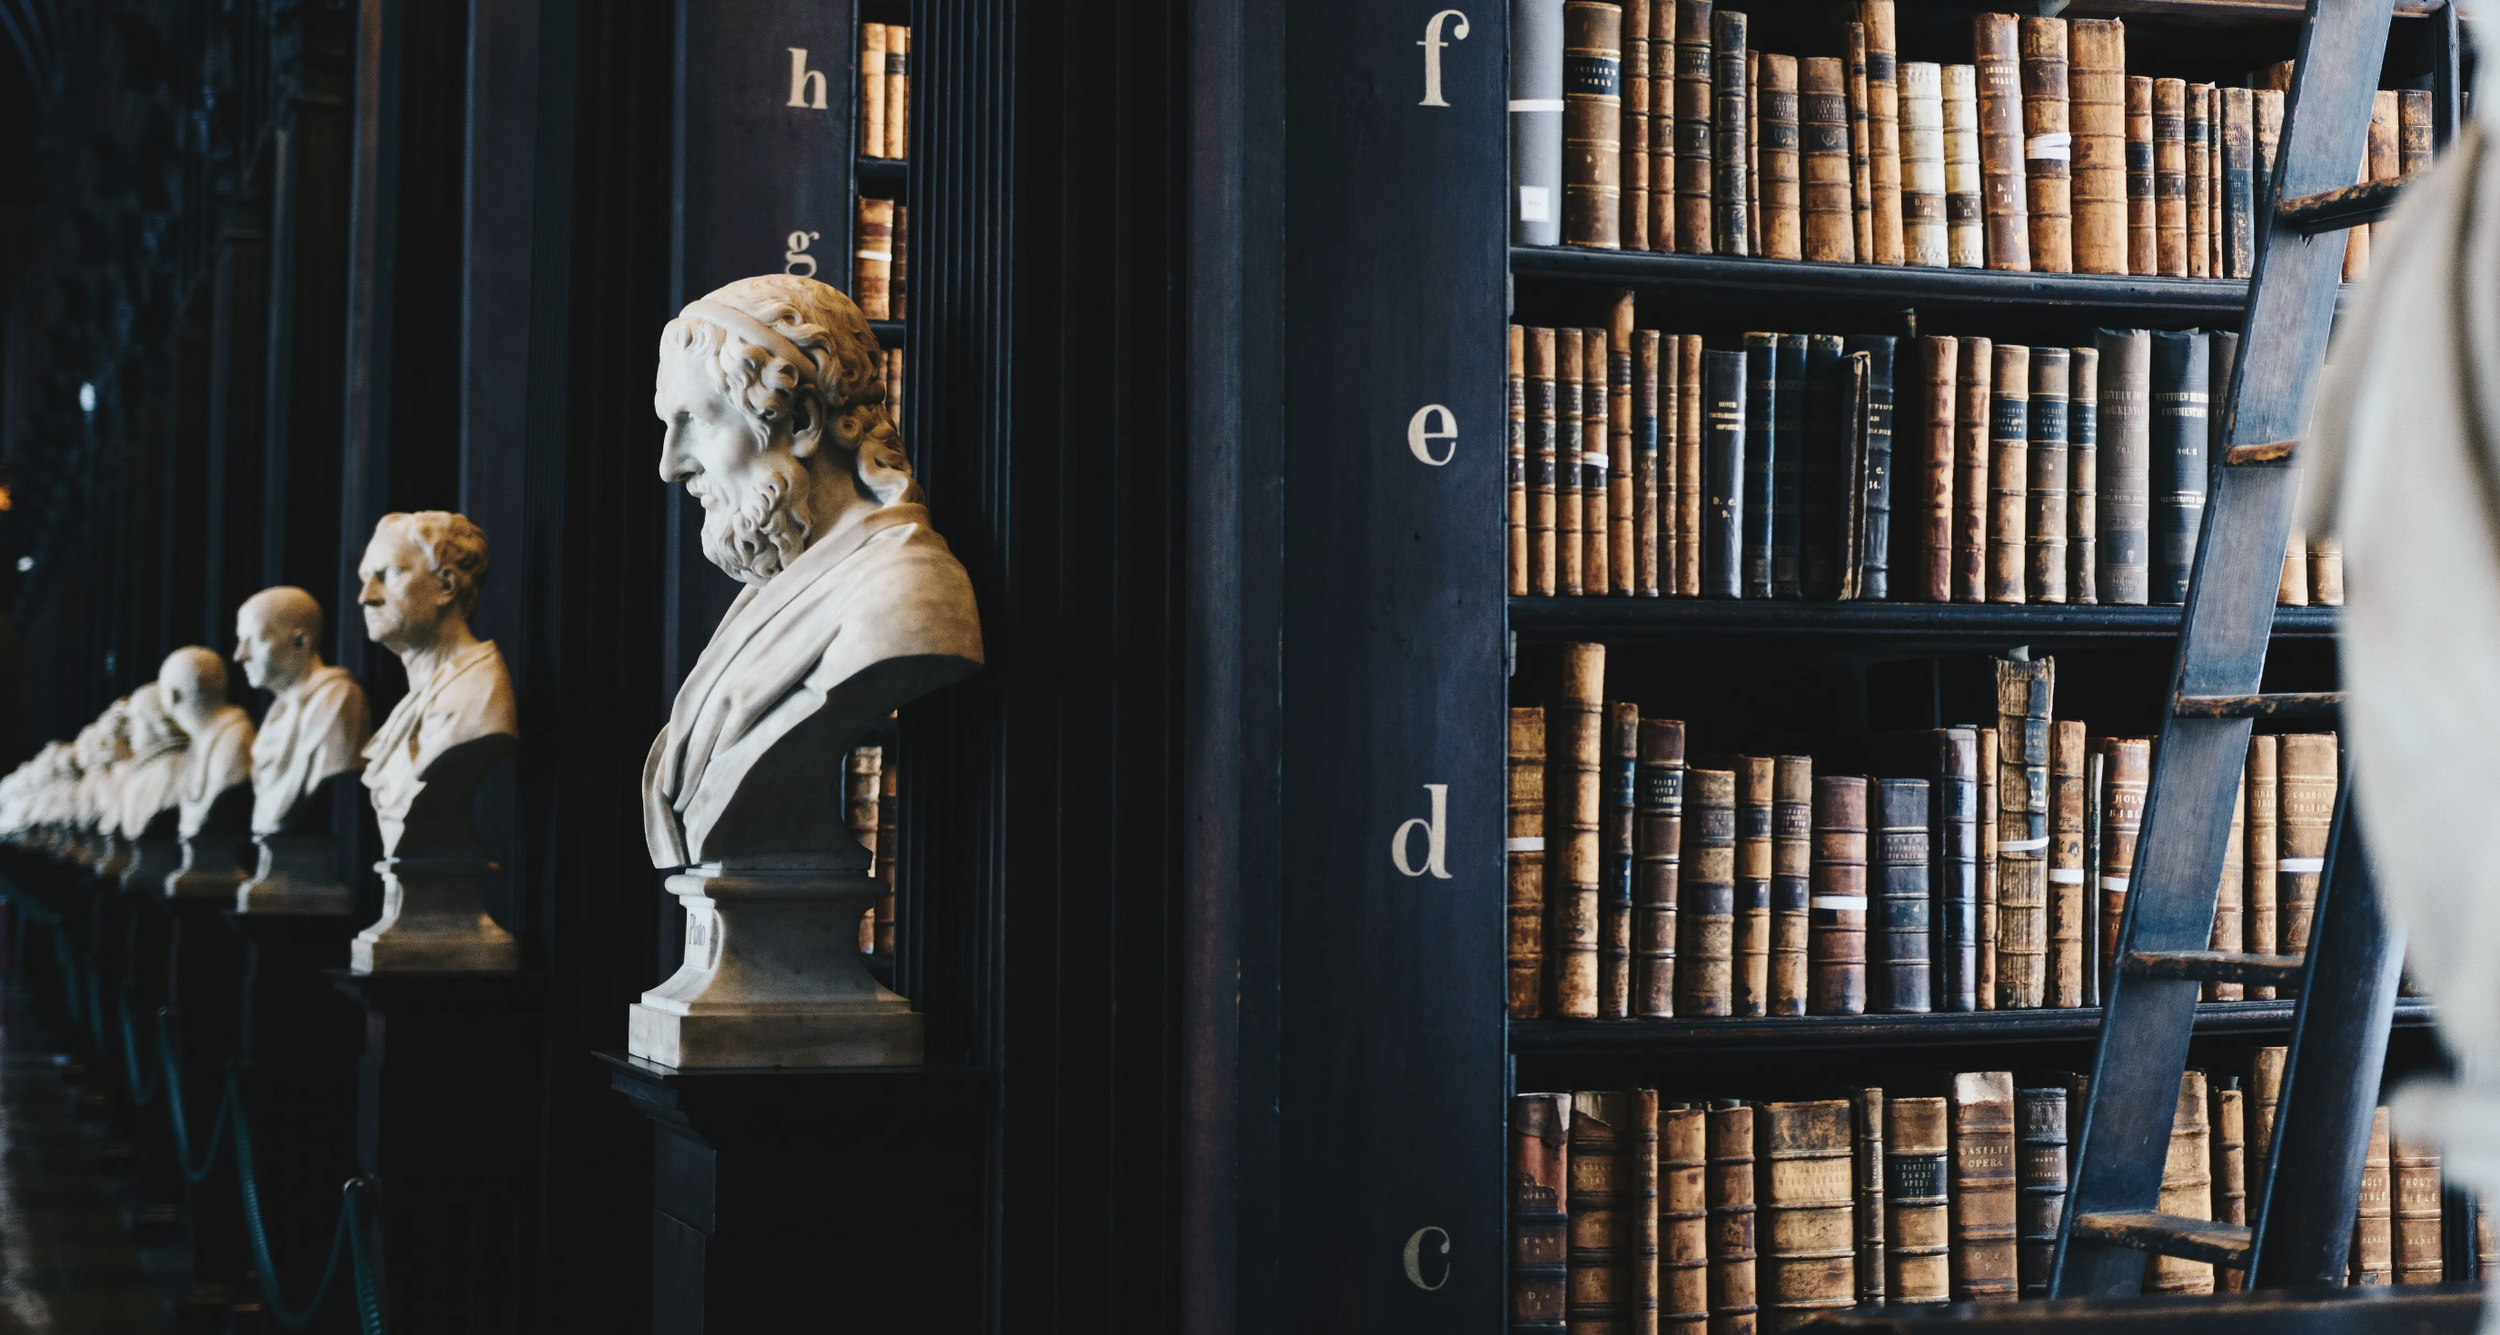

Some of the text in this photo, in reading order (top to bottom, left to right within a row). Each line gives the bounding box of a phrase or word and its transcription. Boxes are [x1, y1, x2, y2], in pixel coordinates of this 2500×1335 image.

[1416, 9, 1470, 107] f
[786, 47, 829, 110] h
[1989, 77, 2014, 85] WORKS
[785, 231, 821, 277] g
[2155, 391, 2189, 402] MATTHEW
[1407, 403, 1459, 466] e
[2293, 790, 2327, 799] COMMON
[2109, 809, 2141, 819] BIBL
[1391, 783, 1453, 879] d
[1960, 1145, 2009, 1156] BASILII
[1968, 1158, 2004, 1168] OPERA
[2361, 1177, 2383, 1186] HOLY
[2405, 1177, 2432, 1187] HOLY
[2358, 1191, 2386, 1201] BIBLE
[2403, 1192, 2437, 1203] BIBLE
[1402, 1225, 1450, 1291] c
